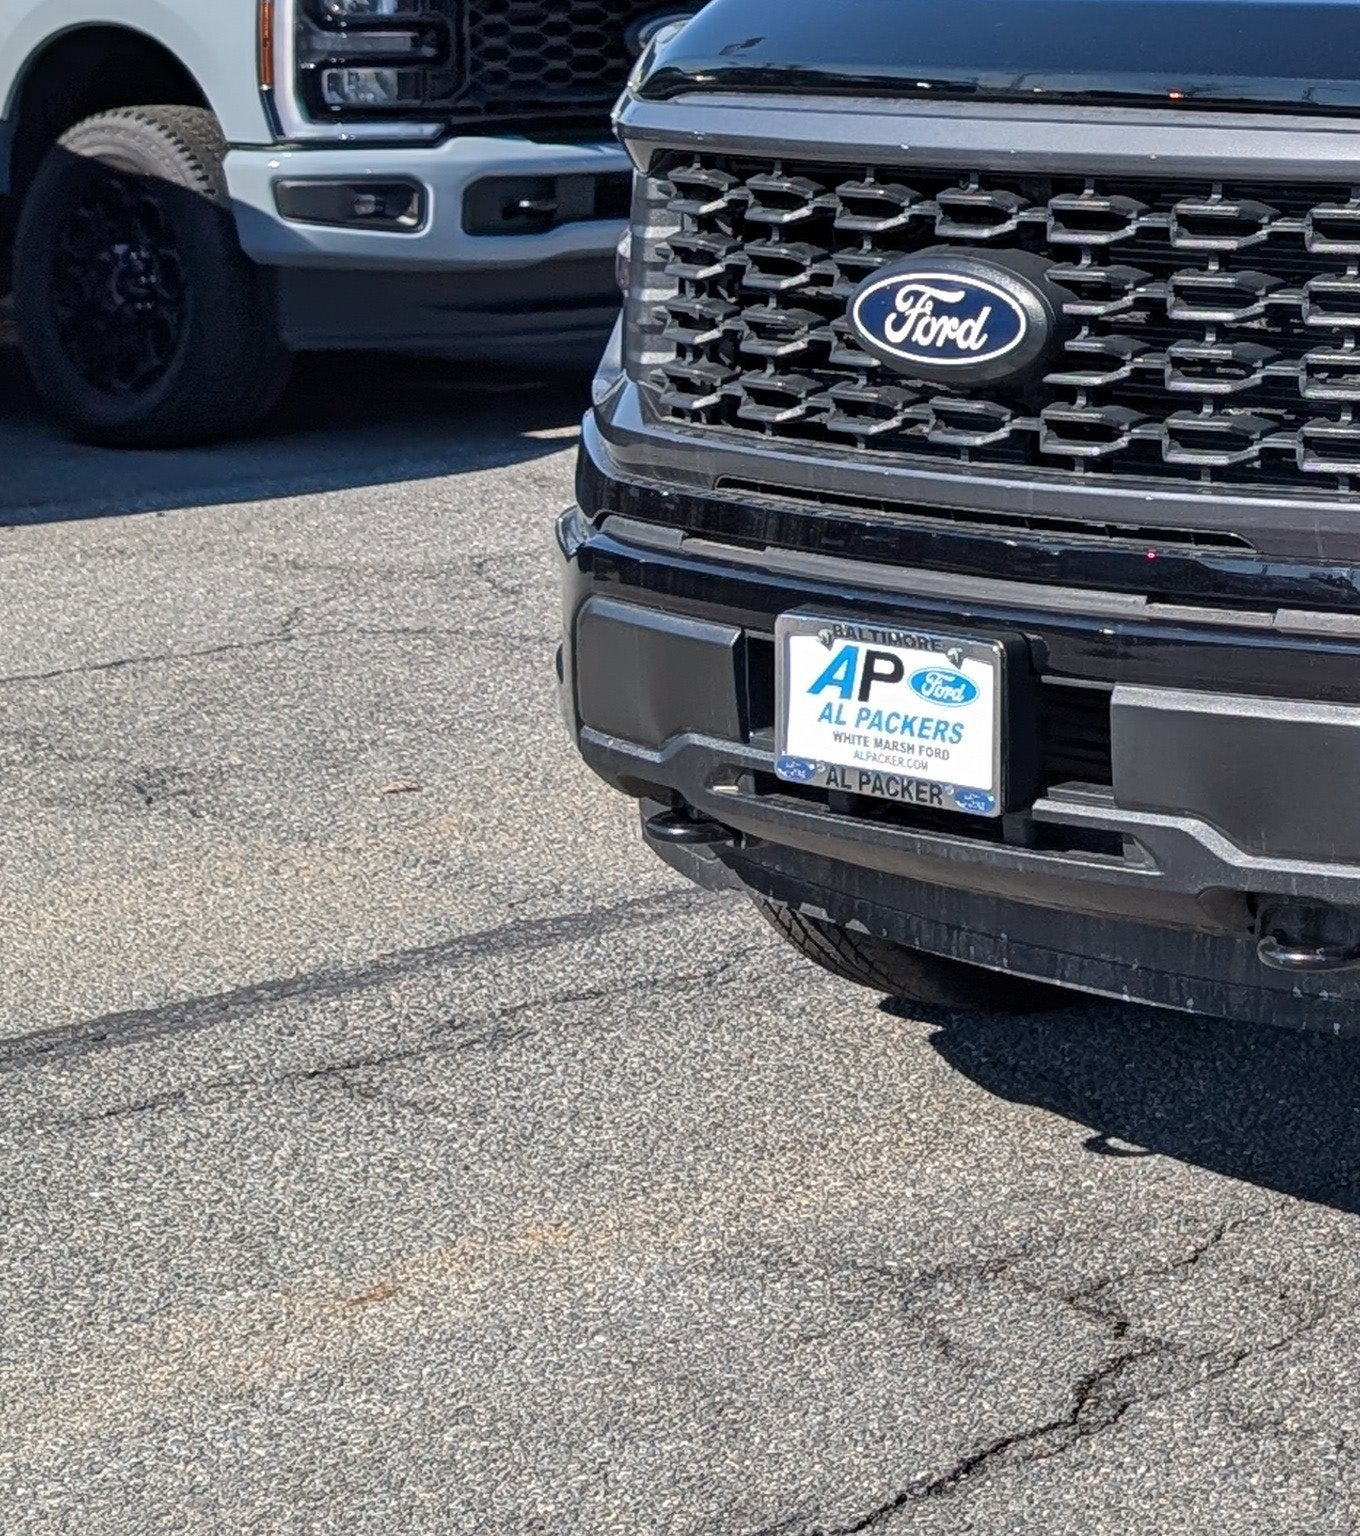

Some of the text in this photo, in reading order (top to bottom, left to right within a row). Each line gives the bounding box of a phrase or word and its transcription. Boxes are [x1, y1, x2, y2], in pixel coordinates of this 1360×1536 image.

[884, 284, 992, 351] Ford
[831, 622, 944, 652] BALTIMORE
[806, 644, 966, 704] AP Ford
[817, 701, 965, 746] AL PACKERS
[832, 730, 951, 762] WHITE MARSH FORD
[852, 749, 929, 772] ALPACKER.COM
[825, 766, 944, 806] AL PACKER
